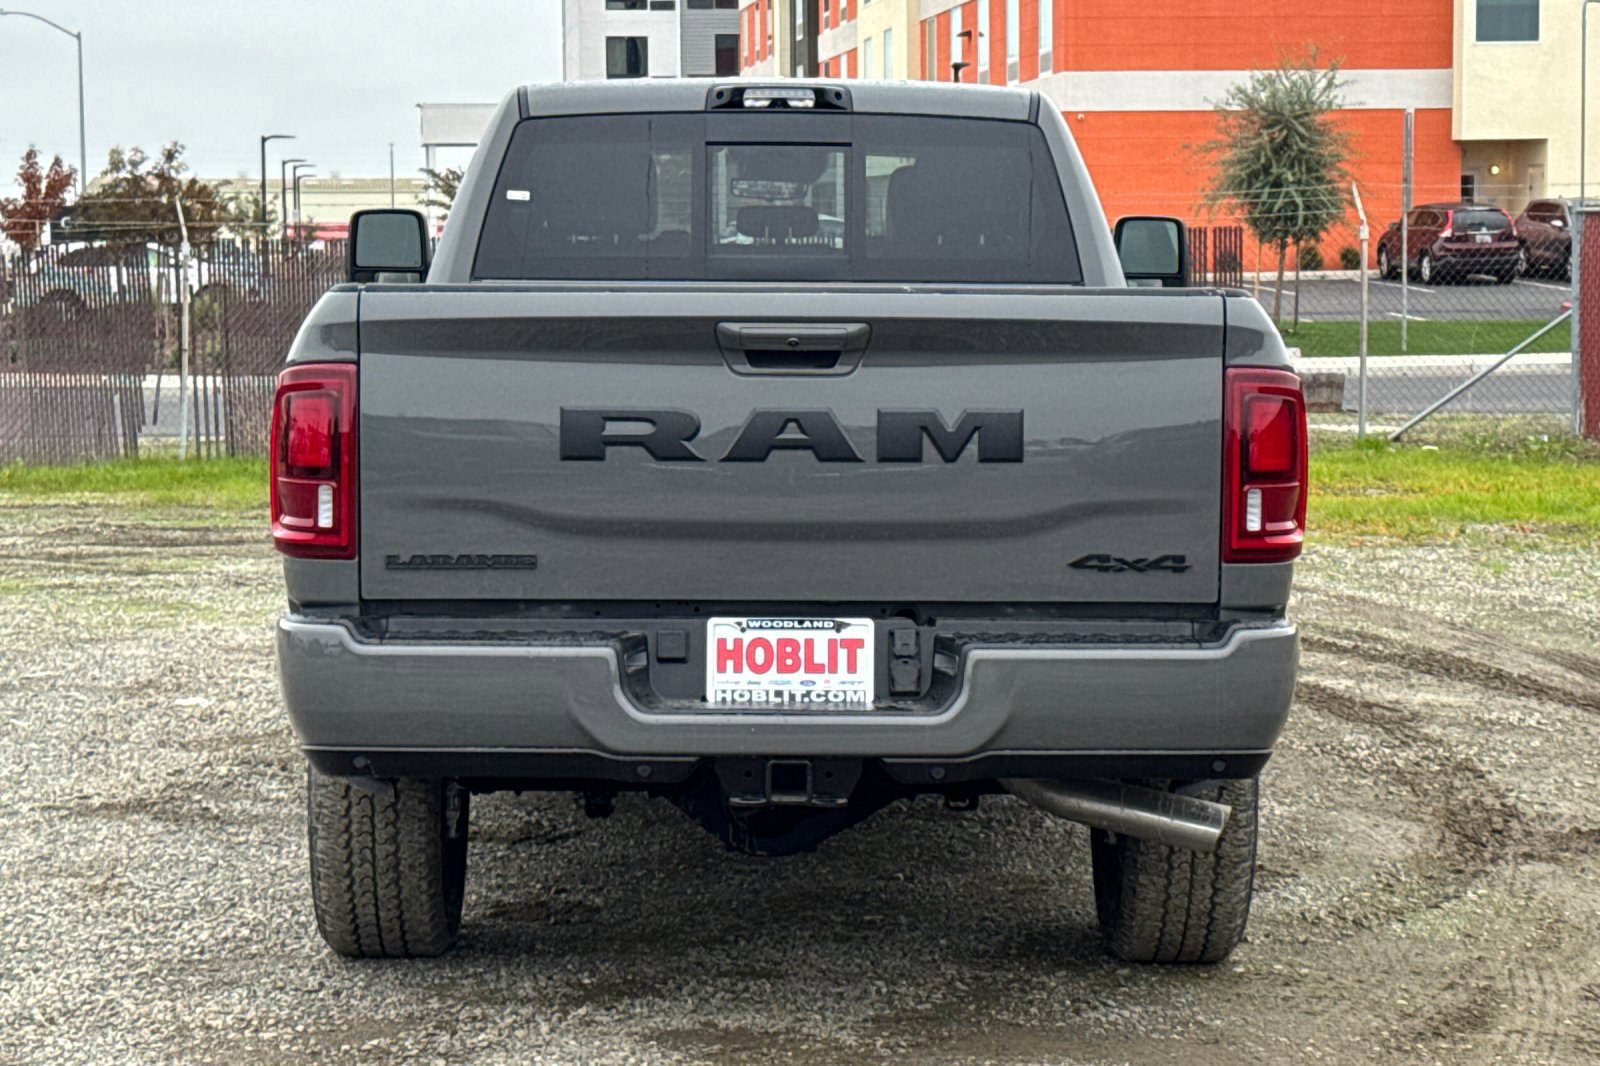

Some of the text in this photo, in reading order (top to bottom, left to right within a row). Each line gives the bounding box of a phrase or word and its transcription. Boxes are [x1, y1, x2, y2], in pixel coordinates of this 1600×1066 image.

[559, 406, 1025, 462] RAM
[385, 554, 537, 570] LARAMIE
[747, 620, 834, 629] WOODLAND
[716, 637, 865, 674] HOBLIT
[715, 689, 866, 702] HOBLIT.COM
